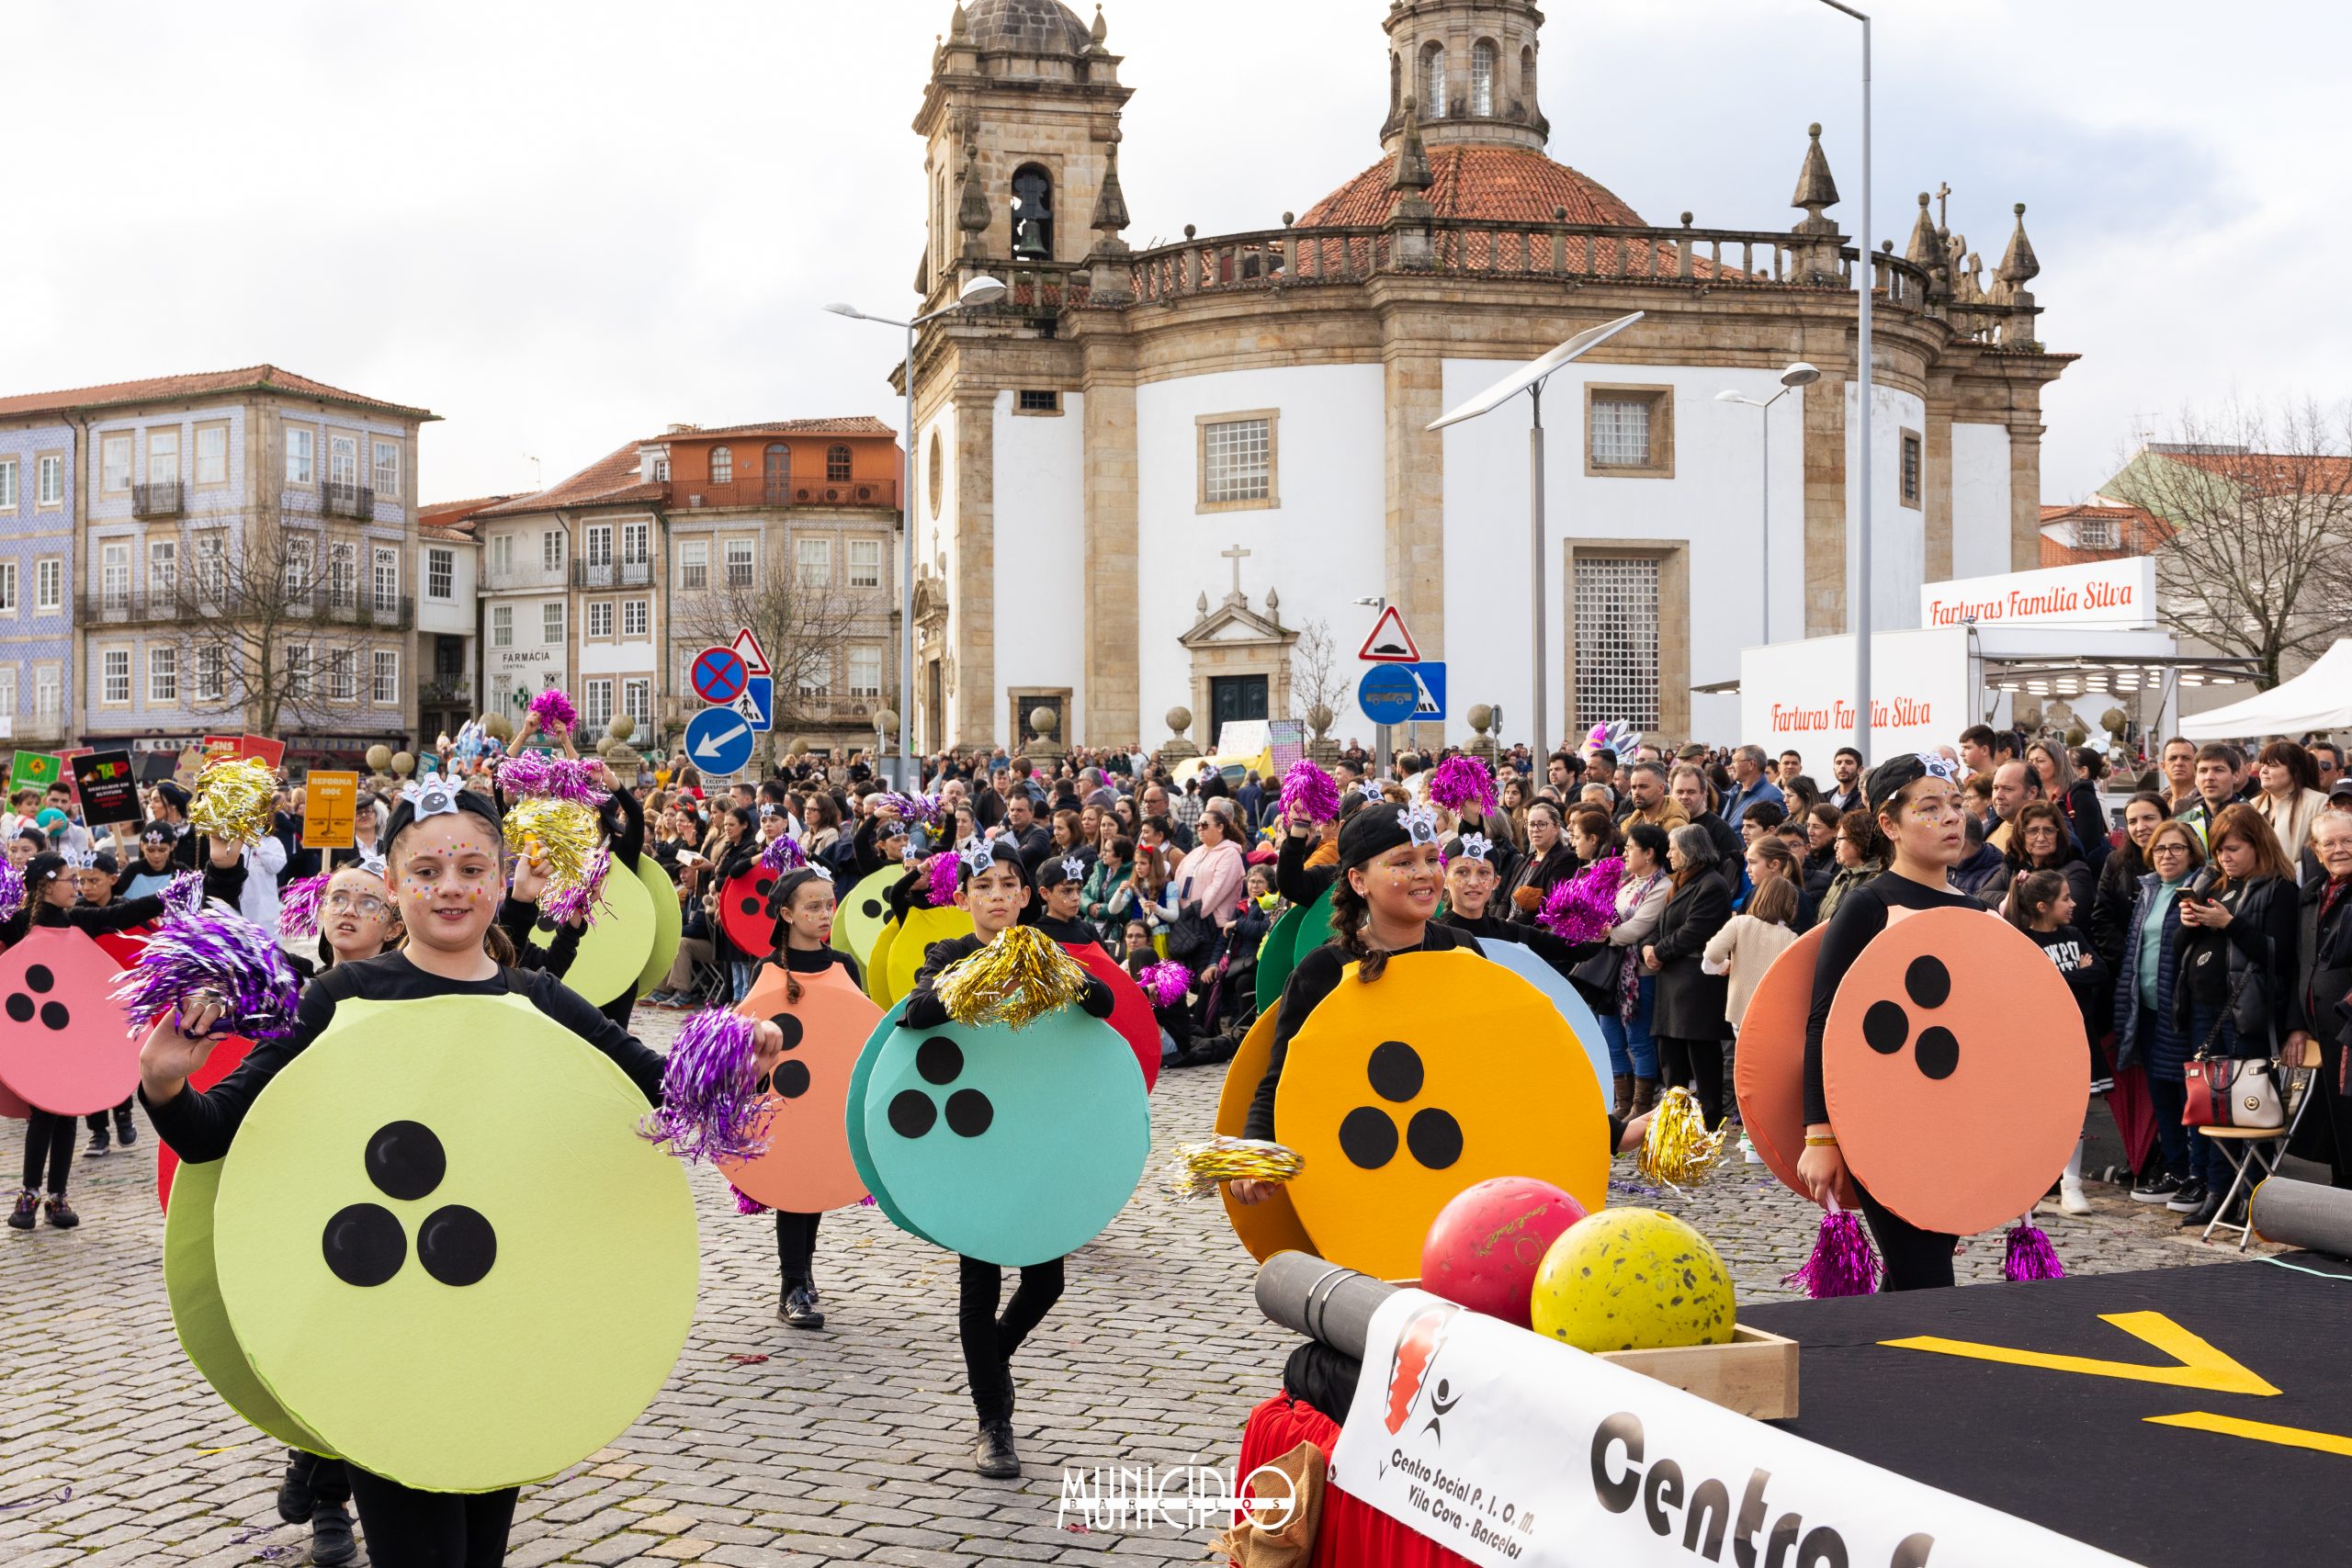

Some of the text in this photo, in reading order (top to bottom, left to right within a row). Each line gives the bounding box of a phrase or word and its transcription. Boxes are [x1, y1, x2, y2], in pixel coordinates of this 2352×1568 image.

[1930, 581, 2132, 626] Farturas Família Silva
[503, 649, 550, 662] FARMÁCIA
[1771, 704, 1828, 732] Farturas
[1893, 696, 1930, 728] Silva
[213, 740, 234, 751] SNS
[96, 761, 129, 780] TAP
[1392, 1449, 1431, 1483] Centro
[1432, 1469, 1470, 1502] Social
[1470, 1487, 1483, 1510] P.
[1487, 1495, 1497, 1517] I.
[1502, 1503, 1515, 1526] O.
[1590, 1411, 1849, 1568] Centro
[1408, 1484, 1430, 1512] Vila
[1431, 1498, 1462, 1529] Cova
[1471, 1518, 1523, 1560] Barcelos
